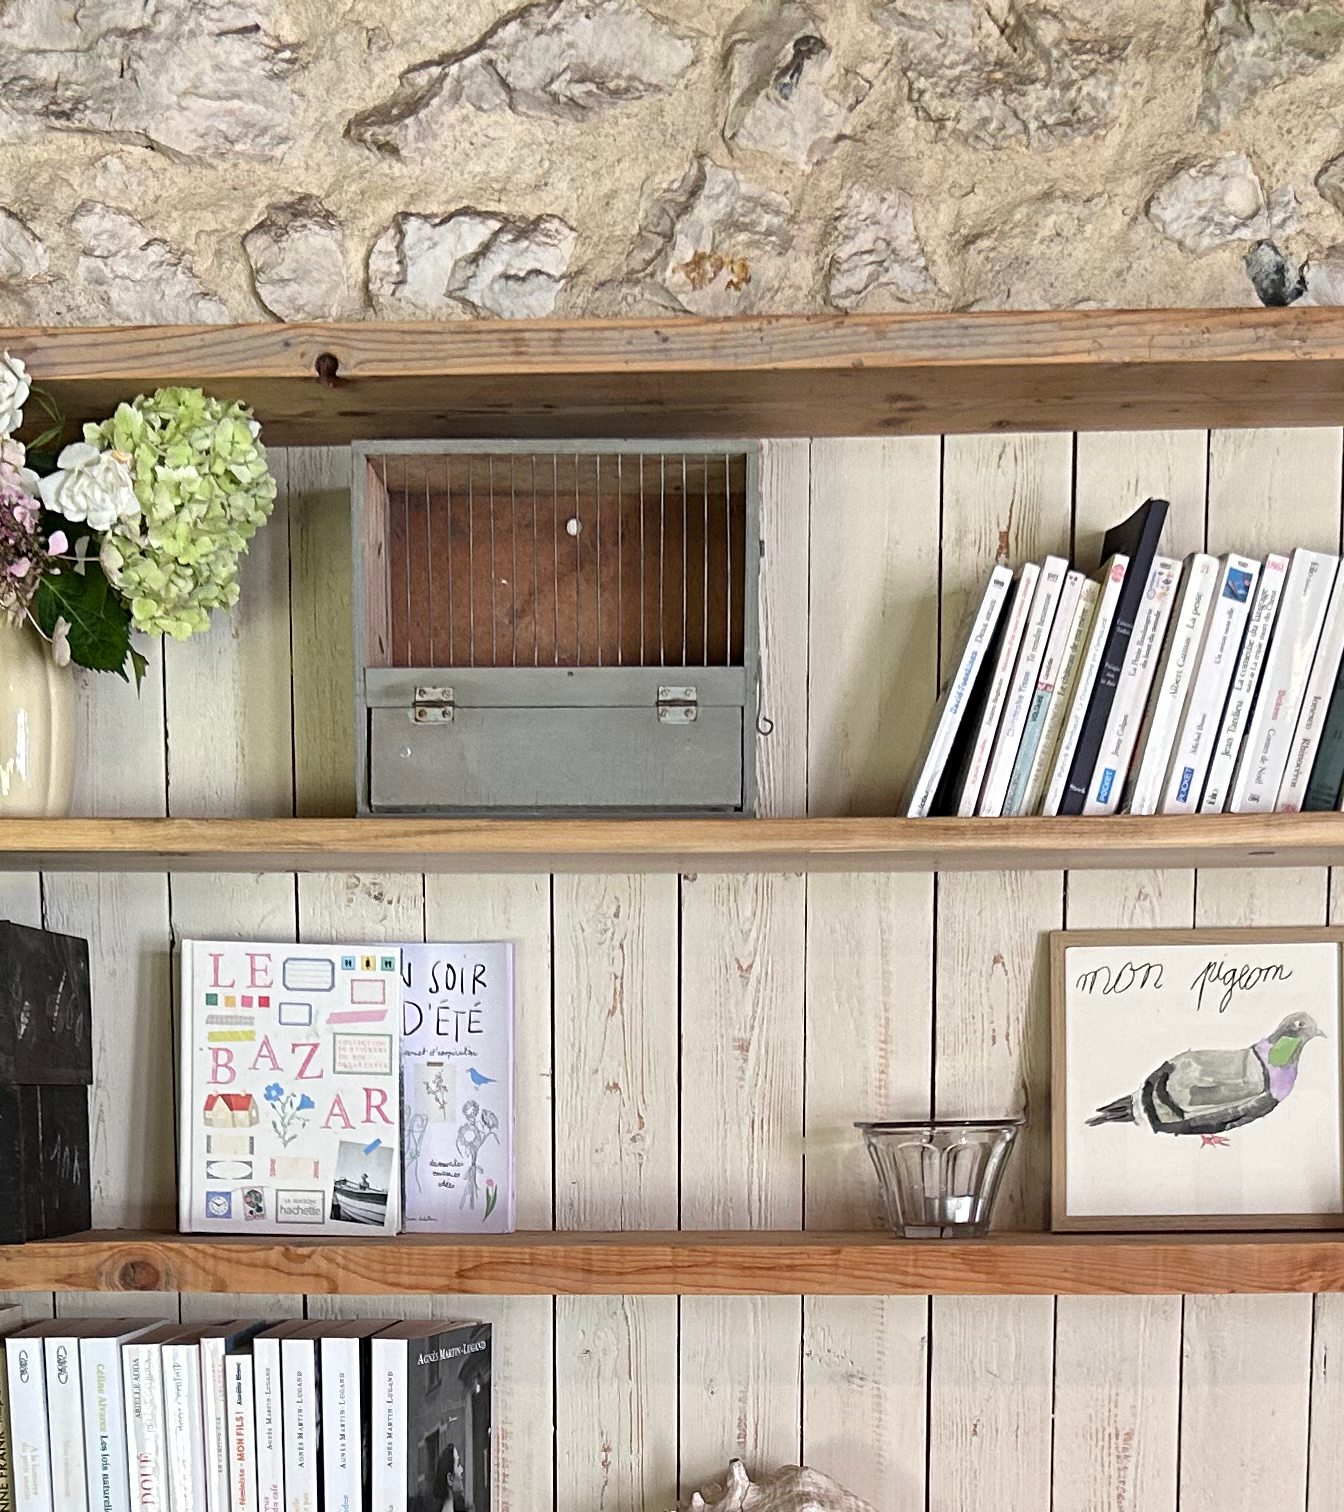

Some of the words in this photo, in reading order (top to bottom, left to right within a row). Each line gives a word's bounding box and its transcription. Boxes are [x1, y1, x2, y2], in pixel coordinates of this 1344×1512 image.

[1097, 768, 1115, 802] POCKET
[1176, 766, 1194, 802] POCKET
[208, 953, 274, 988] LE
[429, 960, 486, 995] SOIR
[1075, 961, 1164, 995] mon
[280, 1204, 321, 1216] hachette
[417, 1351, 439, 1365] AGNÈS
[439, 1340, 487, 1361] MARTIN-LUGAND
[94, 1363, 106, 1393] Céline
[234, 1416, 244, 1436] FILS
[98, 1434, 109, 1451] Les
[235, 1437, 245, 1461] MON
[297, 1441, 305, 1468] AGNÈS
[99, 1453, 110, 1471] lois
[136, 1451, 154, 1504] DOUÉ
